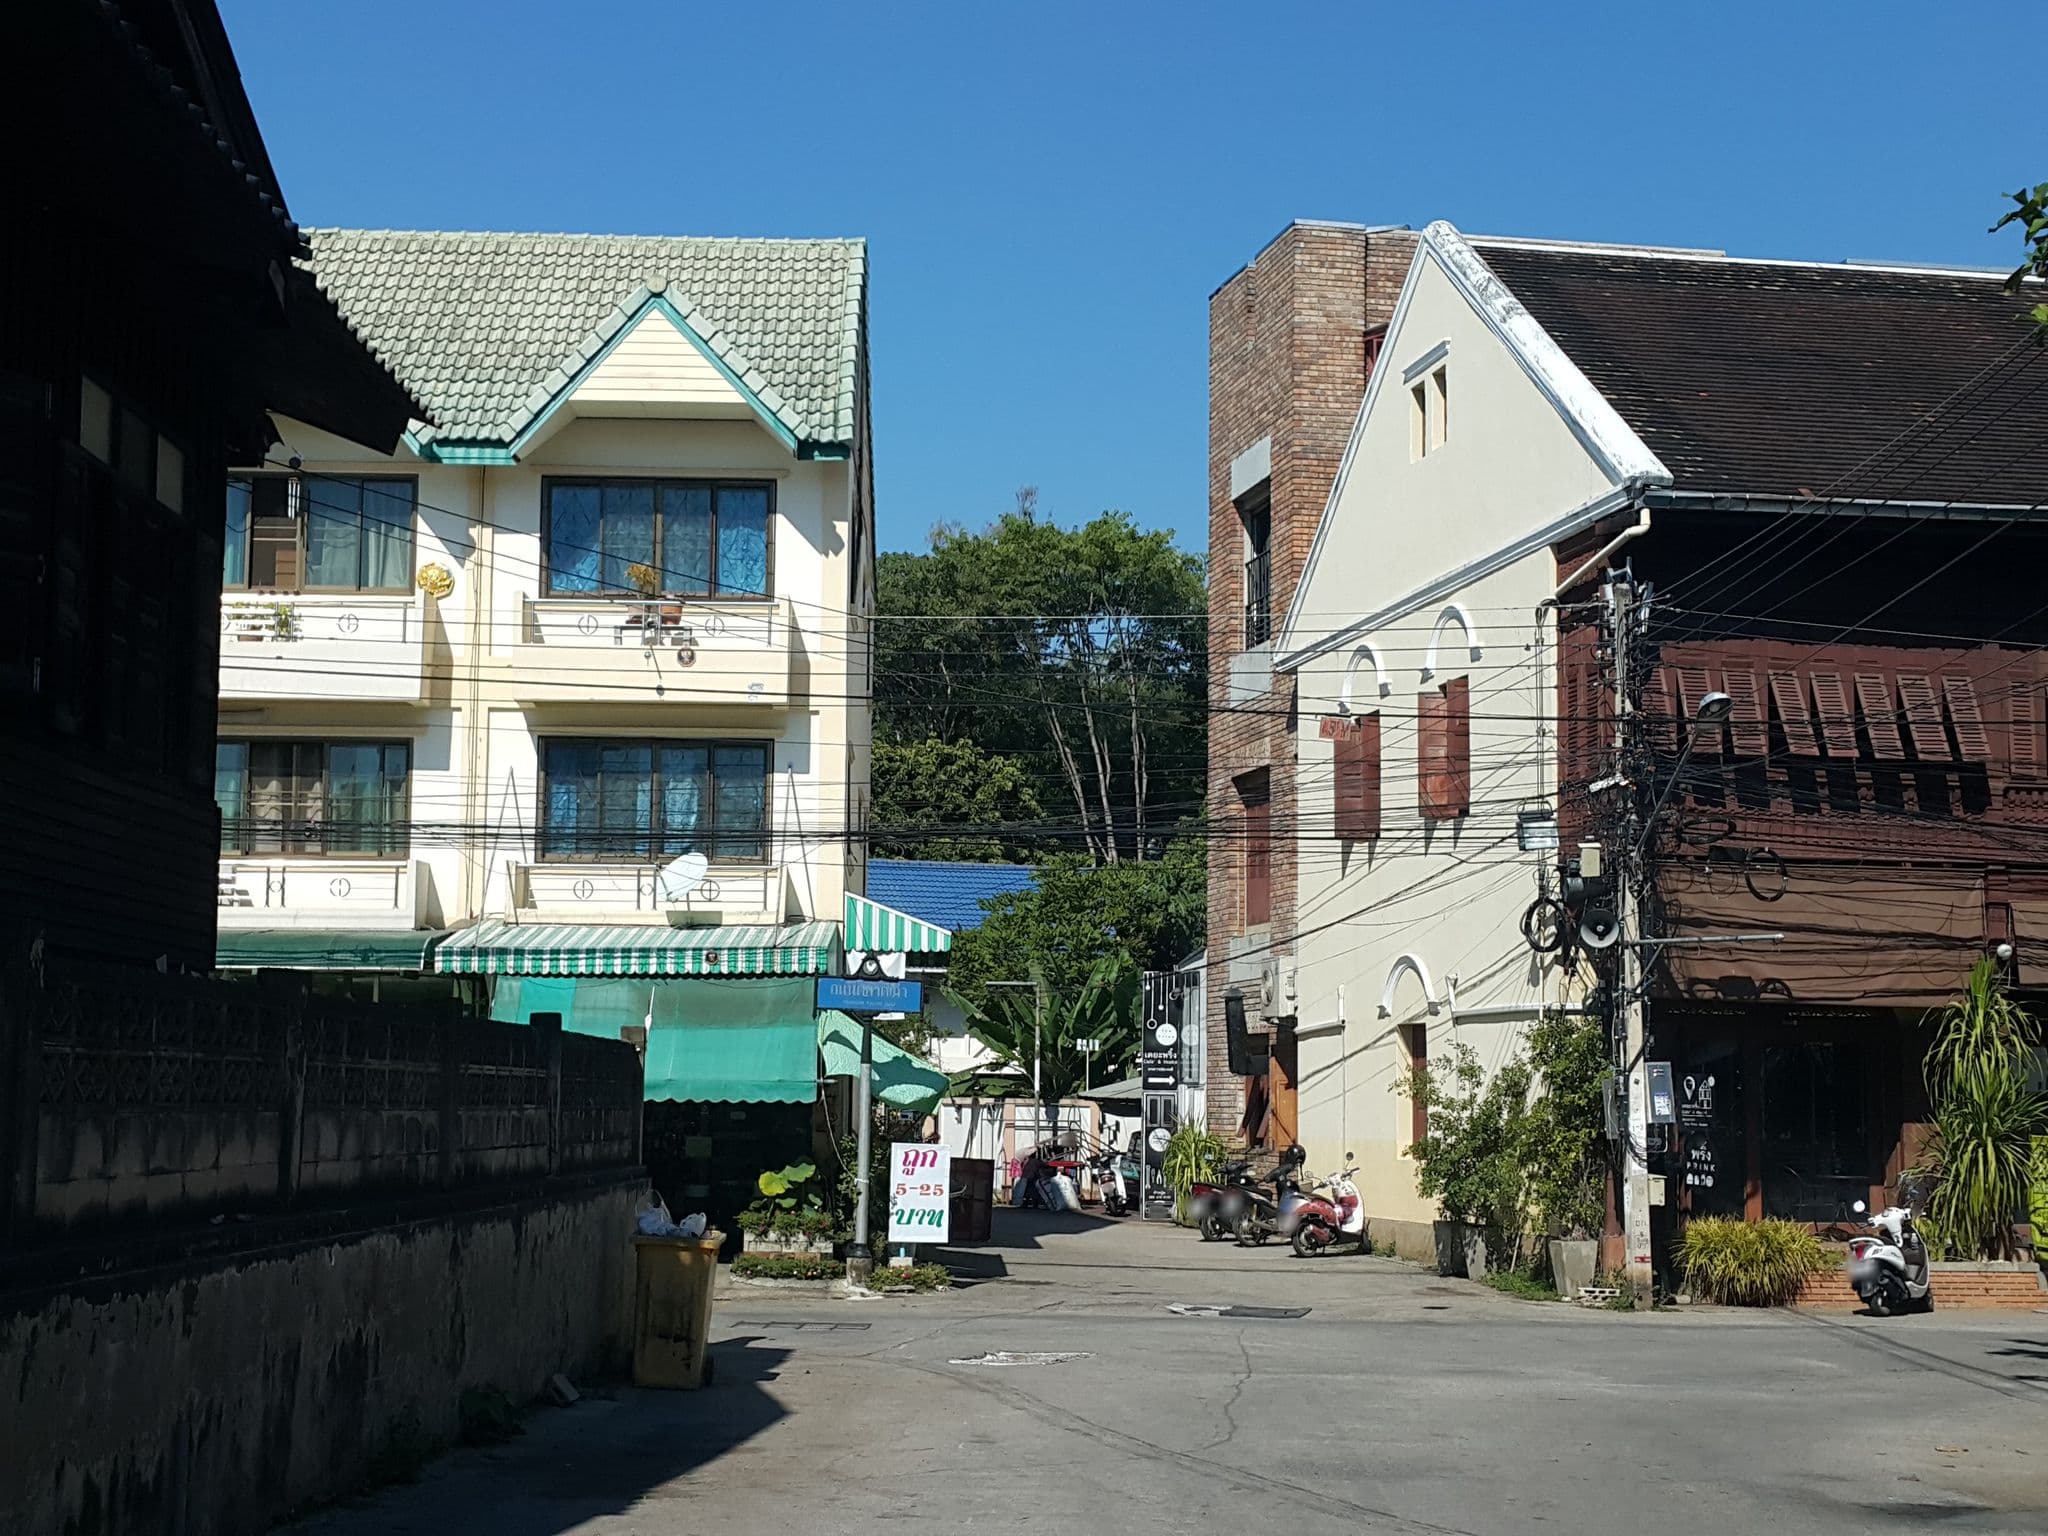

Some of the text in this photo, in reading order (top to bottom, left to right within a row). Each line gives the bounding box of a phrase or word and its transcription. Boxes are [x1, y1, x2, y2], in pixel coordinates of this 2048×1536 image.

[902, 1149, 938, 1176] ถูก
[1686, 1161, 1716, 1172] PRINK
[895, 1183, 944, 1196] 5-25
[895, 1208, 944, 1228] บาท
